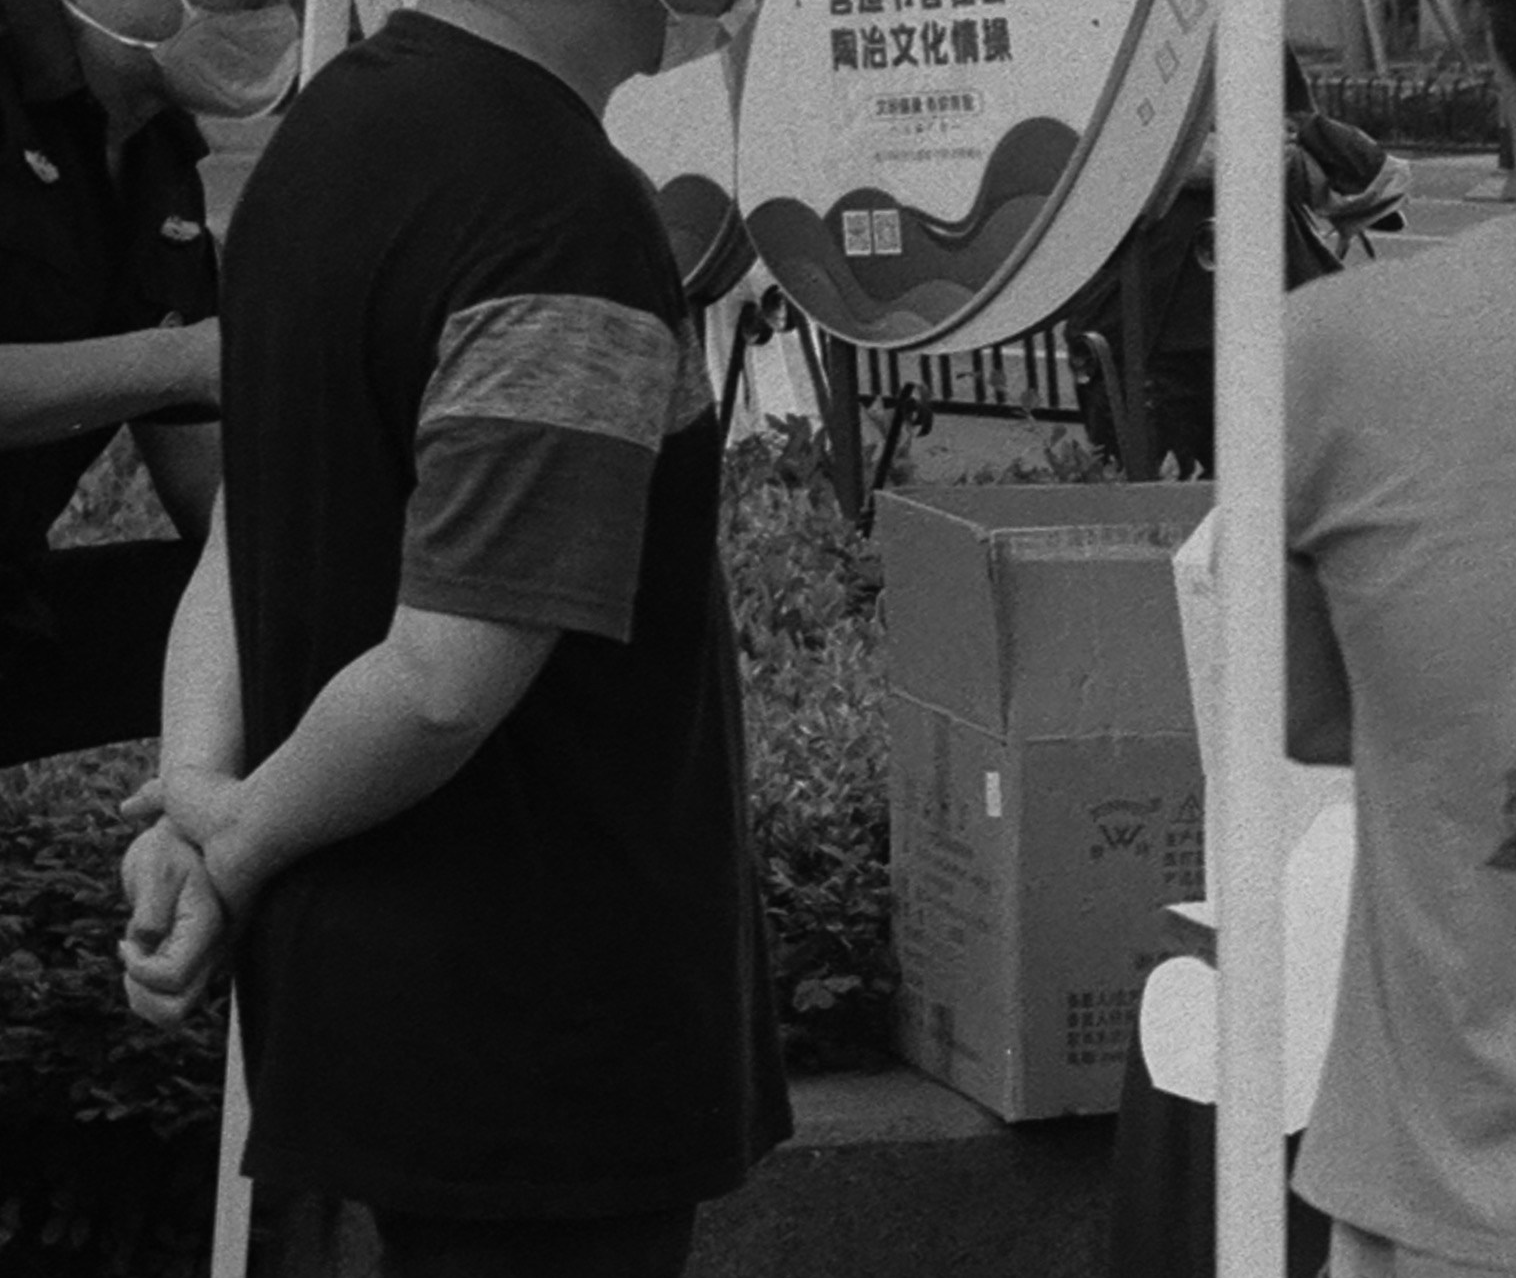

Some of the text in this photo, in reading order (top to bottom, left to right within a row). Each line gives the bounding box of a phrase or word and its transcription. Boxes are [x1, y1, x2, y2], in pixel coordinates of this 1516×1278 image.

[831, 18, 1012, 70] 陶冶文化情操
